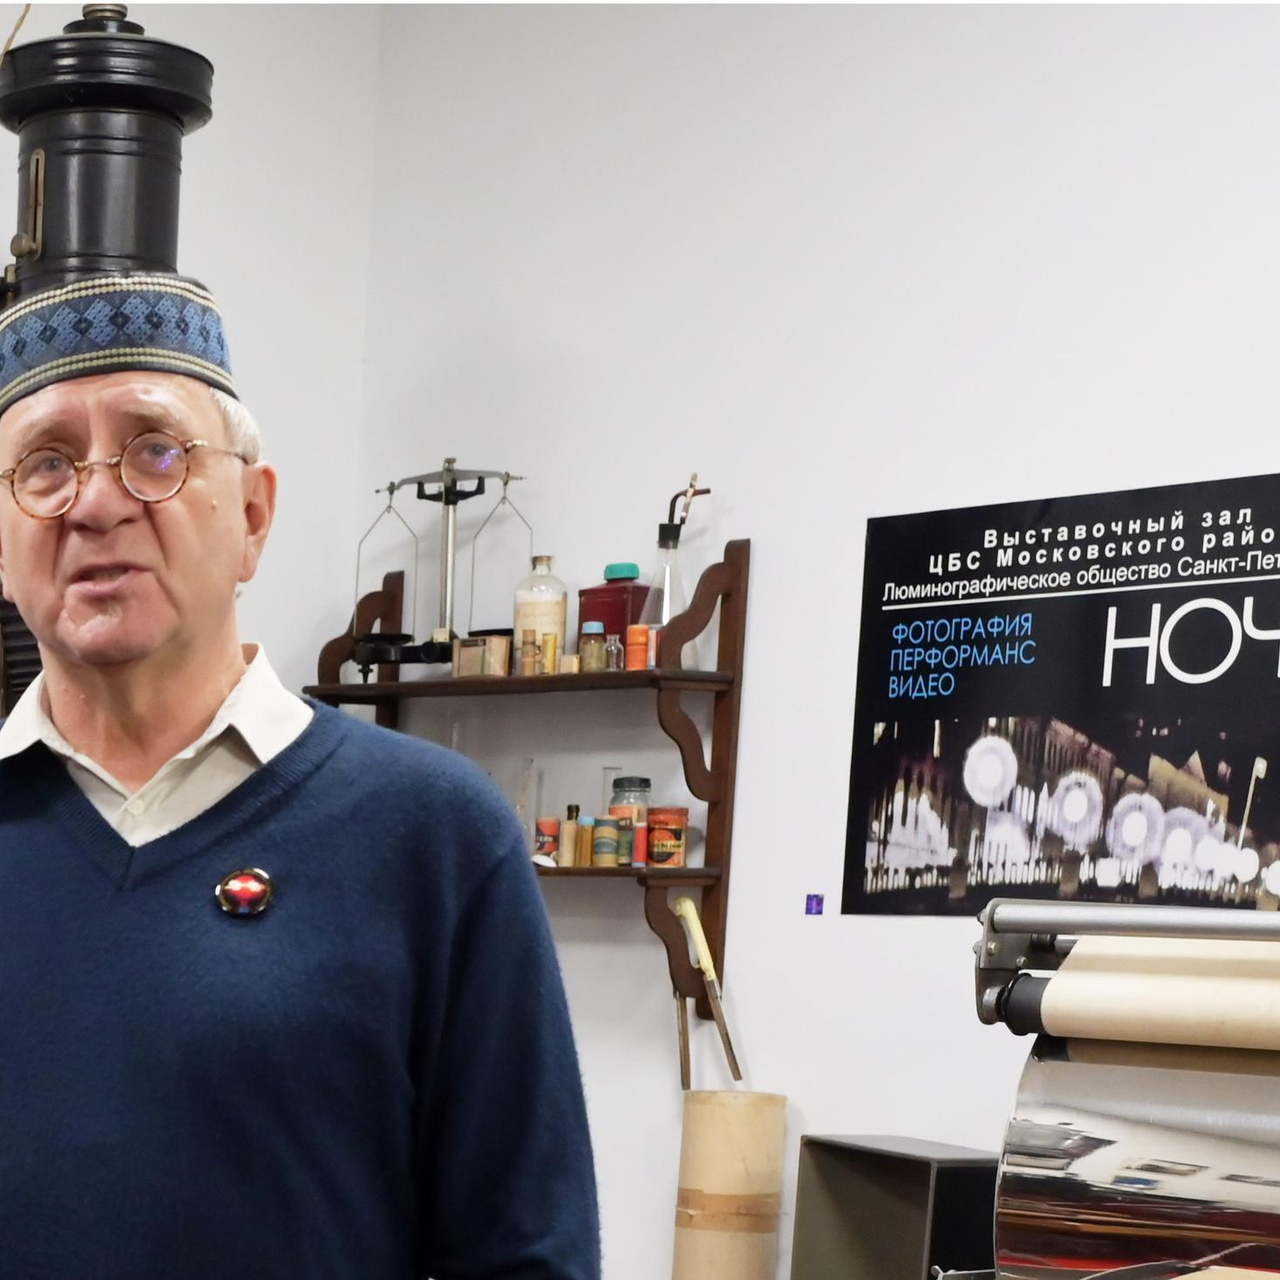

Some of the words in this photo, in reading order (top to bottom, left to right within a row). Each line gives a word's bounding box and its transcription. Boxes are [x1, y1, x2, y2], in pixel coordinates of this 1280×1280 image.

[983, 510, 1184, 549] Выставочный
[1201, 507, 1252, 528] зал
[928, 551, 981, 576] ЦБС
[996, 535, 1185, 568] Московского
[1202, 525, 1275, 554] райо
[882, 571, 1071, 601] Люминографическое
[1076, 562, 1172, 586] общество
[892, 613, 1033, 645] ФОТОГРАФИЯ
[890, 640, 1037, 672] ПЕРФОРМАНС
[888, 672, 956, 700] ВИДЕО
